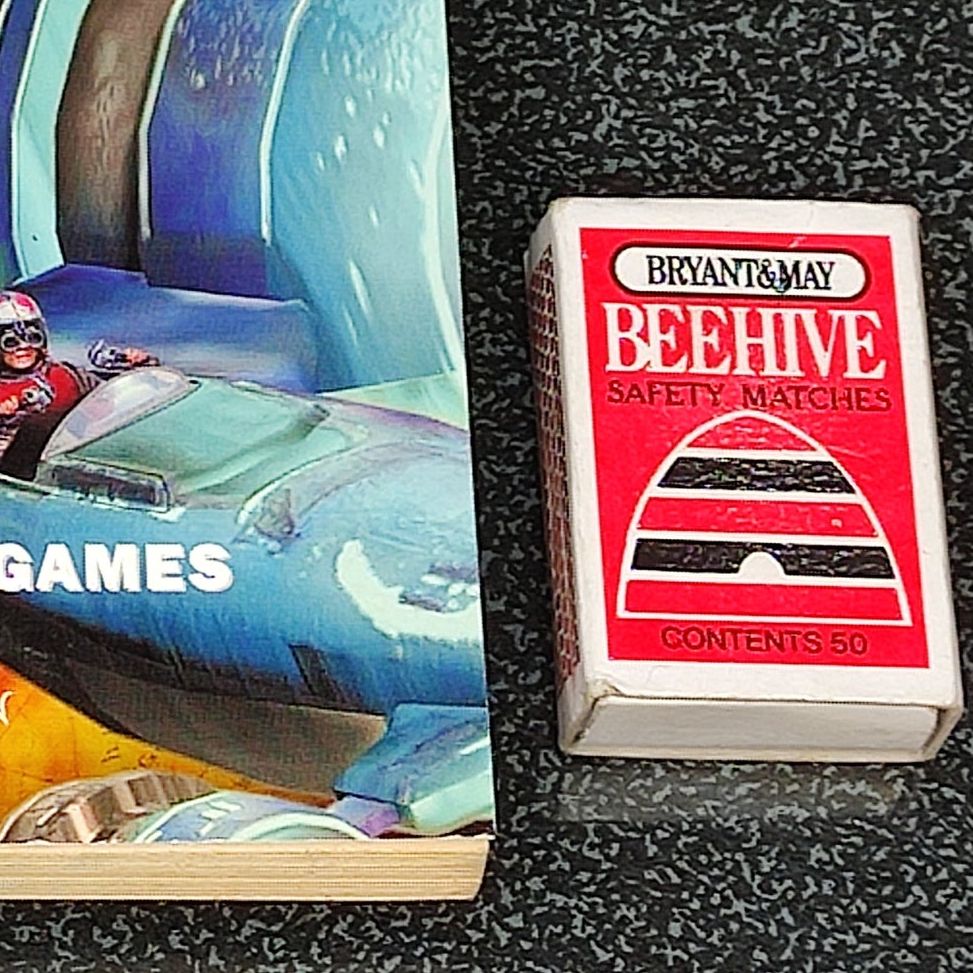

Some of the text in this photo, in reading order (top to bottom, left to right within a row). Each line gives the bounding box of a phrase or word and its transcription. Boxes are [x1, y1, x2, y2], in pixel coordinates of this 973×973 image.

[601, 301, 887, 379] BEEHIVE
[607, 380, 893, 412] SAFETY MATCHES
[661, 625, 868, 656] CONTENTS 50
